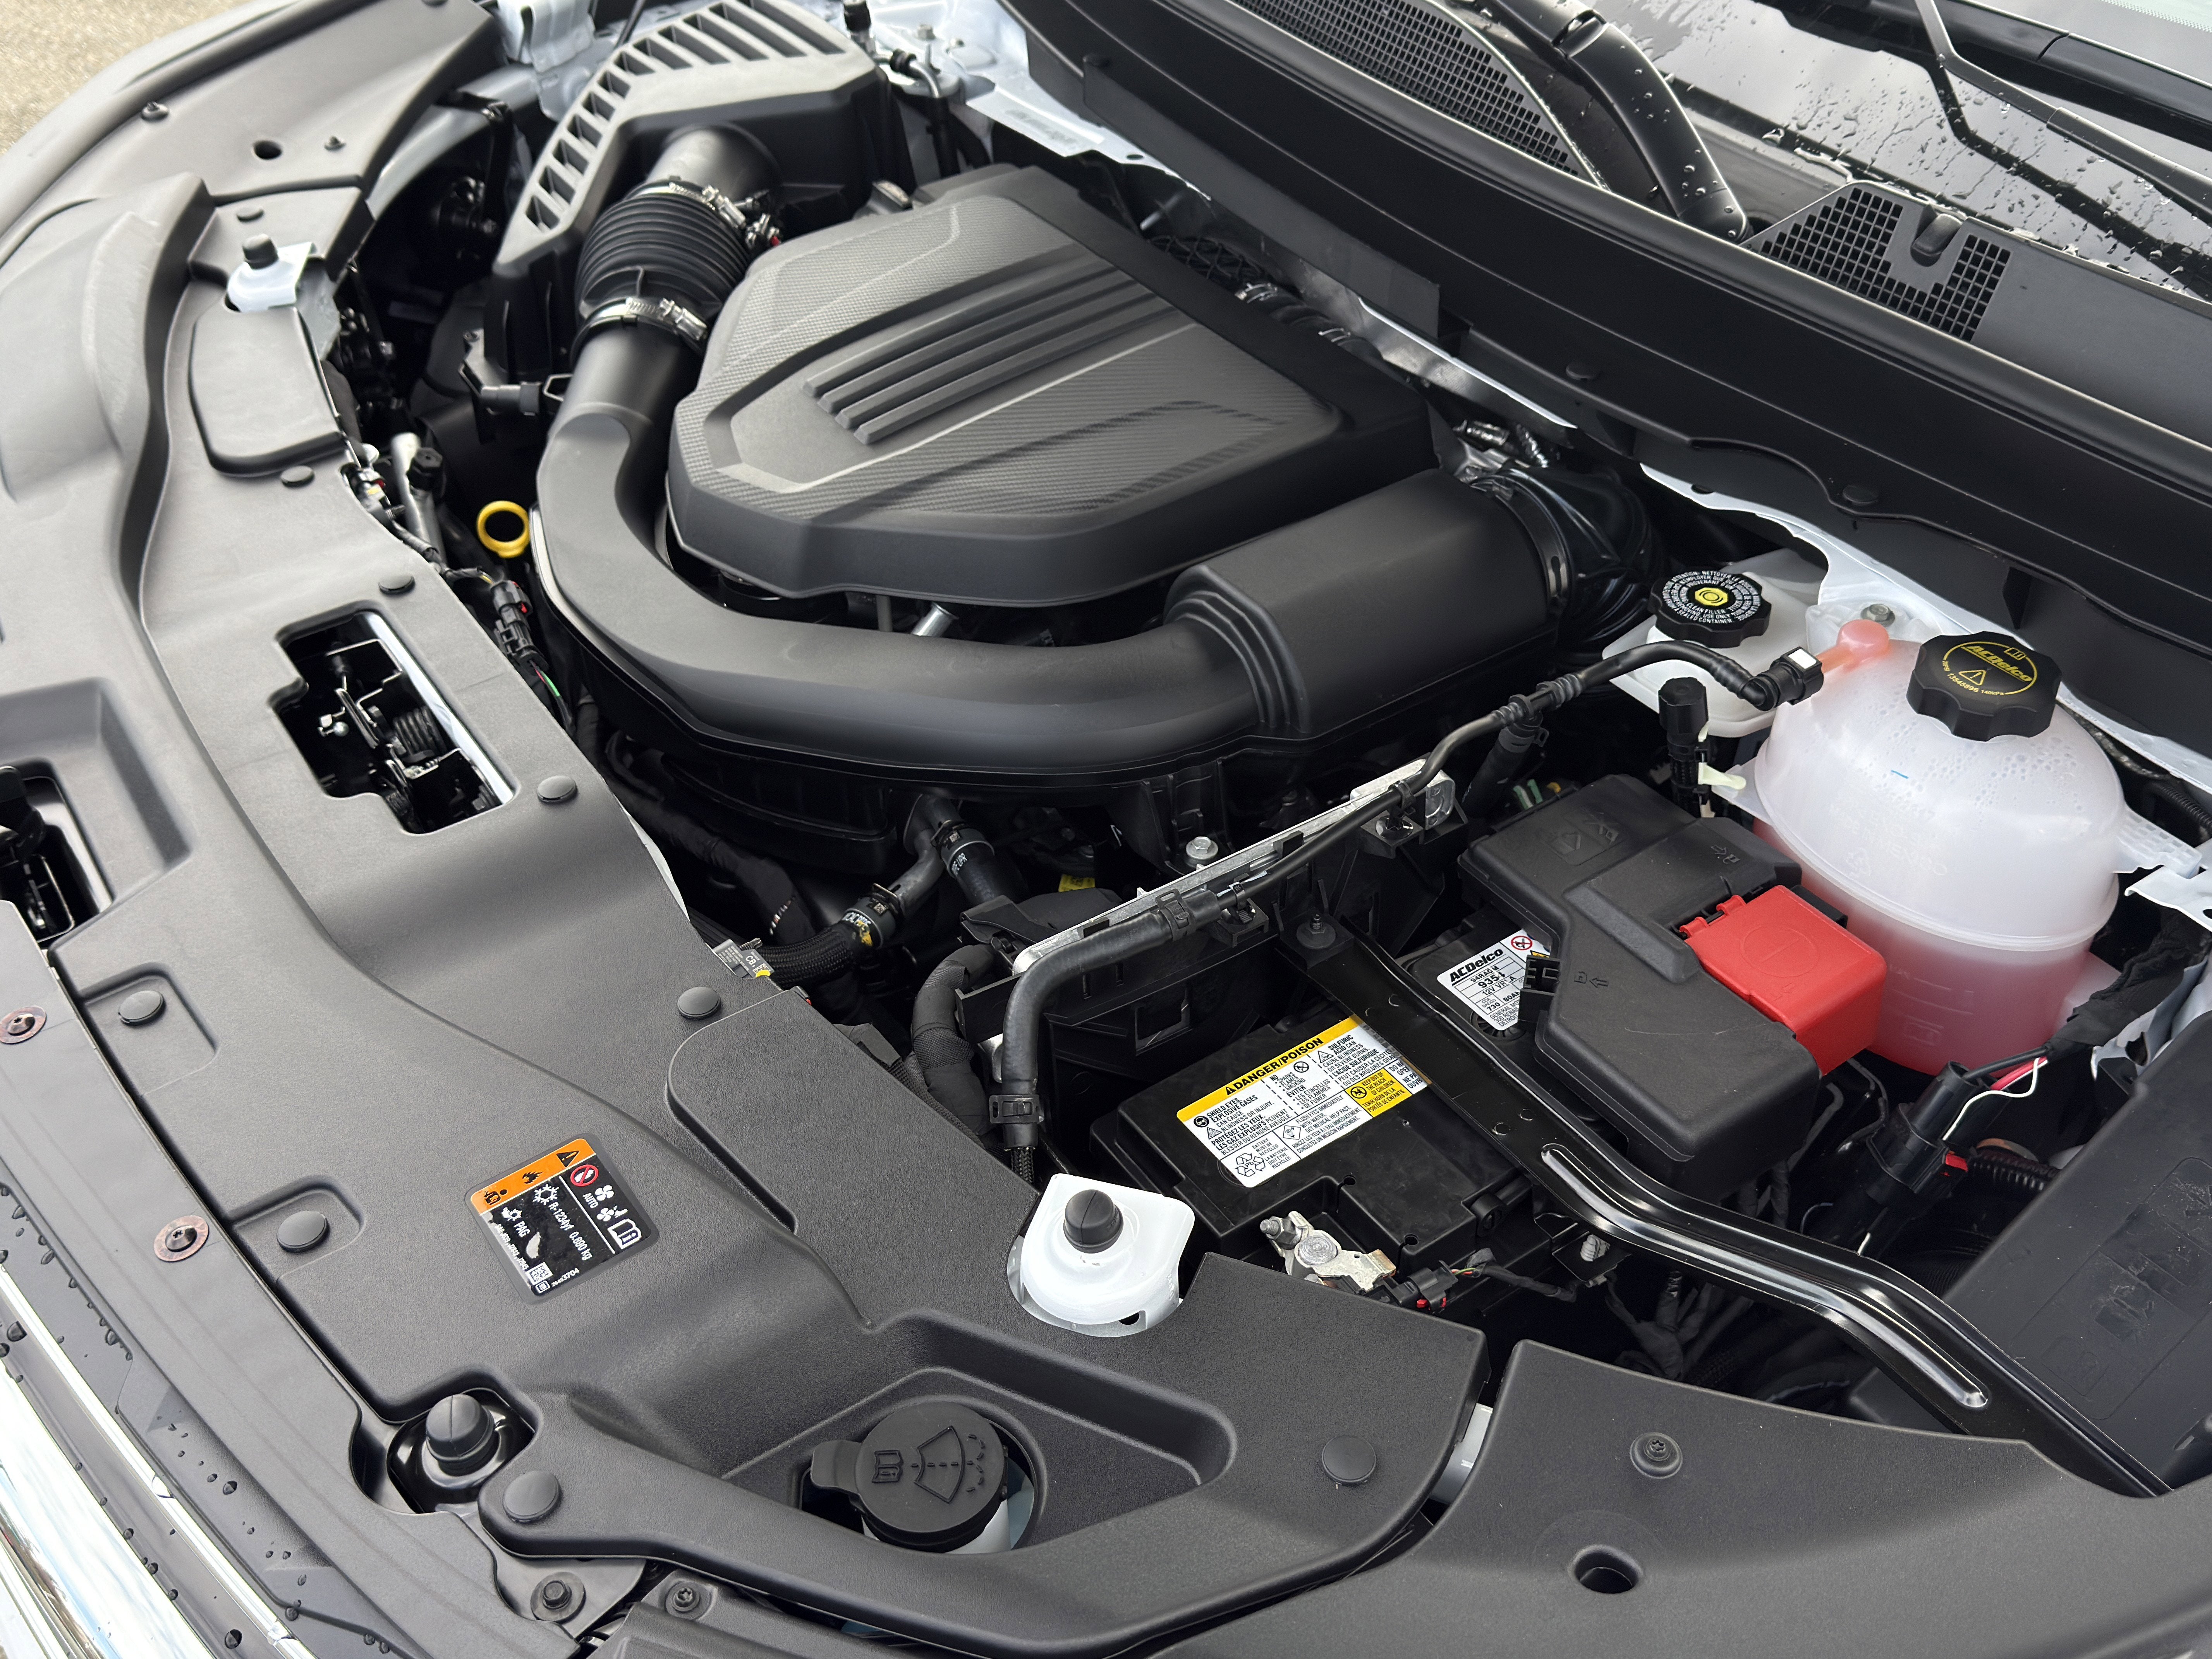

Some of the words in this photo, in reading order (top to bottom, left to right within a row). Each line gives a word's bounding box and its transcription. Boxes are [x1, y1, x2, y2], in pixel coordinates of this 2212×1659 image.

[1686, 603, 1704, 613] CLEAN
[1966, 646, 2032, 682] ACDelco
[1947, 673, 1979, 692] 13545896
[745, 955, 756, 965] CB
[1450, 949, 1503, 982] ACDelco
[1482, 986, 1495, 996] 12V
[1486, 1002, 1500, 1011] 730
[1503, 991, 1520, 1002] 80Ah
[1489, 1006, 1512, 1019] GENERAL
[1328, 1035, 1353, 1051] SULFURIC
[1333, 1045, 1346, 1055] ACID
[1233, 1038, 1323, 1089] DANGER/POISON
[1322, 1057, 1339, 1068] CAUSE
[1337, 1043, 1364, 1060] BLINDNESS
[1332, 1065, 1351, 1077] L'ACIDE
[1349, 1049, 1379, 1067] SULFURIQUE
[1334, 1056, 1353, 1068] SEVERE
[1351, 1048, 1370, 1058] BURNS.
[1338, 1072, 1351, 1082] PEUT
[1350, 1063, 1369, 1075] CAUSER
[1357, 1060, 1384, 1077] BRÛLURES
[1277, 1072, 1295, 1084] SPARKS
[1281, 1075, 1299, 1087] FLAMES
[1285, 1078, 1306, 1091] SMOKING
[1373, 1077, 1387, 1087] REACH
[1376, 1080, 1396, 1092] CHILDREN.
[1286, 1085, 1306, 1097] ÉVITER
[1304, 1079, 1331, 1096] ÉTINCELLES
[1308, 1085, 1331, 1099] FLAMMES
[1206, 1106, 1226, 1118] SHIELD
[1224, 1097, 1242, 1108] EYES.
[1310, 1094, 1328, 1105] FUMER
[1362, 1099, 1375, 1108] TENIR
[1373, 1093, 1386, 1102] HORS
[1367, 1101, 1384, 1112] PORTÉE
[1386, 1089, 1405, 1102] ENFANTS.
[1211, 1104, 1241, 1123] EXPLOSIVE
[1239, 1095, 1258, 1107] GASES
[1221, 1115, 1248, 1132] BLINDNESS
[1254, 1101, 1274, 1113] INJURY.
[1295, 1114, 1310, 1124] FLUSH
[1308, 1109, 1319, 1117] EYES
[1317, 1095, 1343, 1111] IMMEDIATELY
[1312, 1117, 1331, 1129] MEDICAL
[1329, 1111, 1340, 1120] HELP
[1339, 1105, 1351, 1114] FAST.
[1216, 1119, 1228, 1127] CAN
[1226, 1110, 1243, 1121] CAUSE
[1300, 1120, 1312, 1128] WITH
[1310, 1113, 1327, 1123] WATER.
[1211, 1126, 1240, 1146] PROTÉGEZ
[1237, 1122, 1249, 1131] LES
[1247, 1114, 1266, 1125] YEUX.
[1216, 1142, 1228, 1151] LES
[1226, 1136, 1239, 1145] GAZ
[1237, 1120, 1267, 1139] EXPLOSIFS
[1265, 1109, 1287, 1123] PEUVENT
[1221, 1141, 1243, 1155] BLESSER
[1249, 1125, 1270, 1139] RENDRE
[1269, 1114, 1293, 1128] AVEUGLE.
[1291, 1139, 1306, 1149] RINCEZ
[1332, 1107, 1362, 1126] IMMÉDIATEMENT.
[1297, 1139, 1318, 1153] CONSULTEZ
[1321, 1127, 1338, 1139] MÉDECIN
[1336, 1116, 1360, 1131] RAPIDEMENT.
[1252, 1138, 1269, 1149] BATTERY
[1259, 1144, 1279, 1156] RECYCLED
[1269, 1147, 1288, 1159] BATTERIE
[1276, 1152, 1288, 1160] ÊTRE
[1271, 1156, 1291, 1169] RECYCLÉE
[583, 1193, 599, 1208] AUTO
[514, 1221, 530, 1237] PAG
[548, 1202, 574, 1230] R-1234yf
[569, 1231, 587, 1251] 0.890
[581, 1248, 592, 1261] kg
